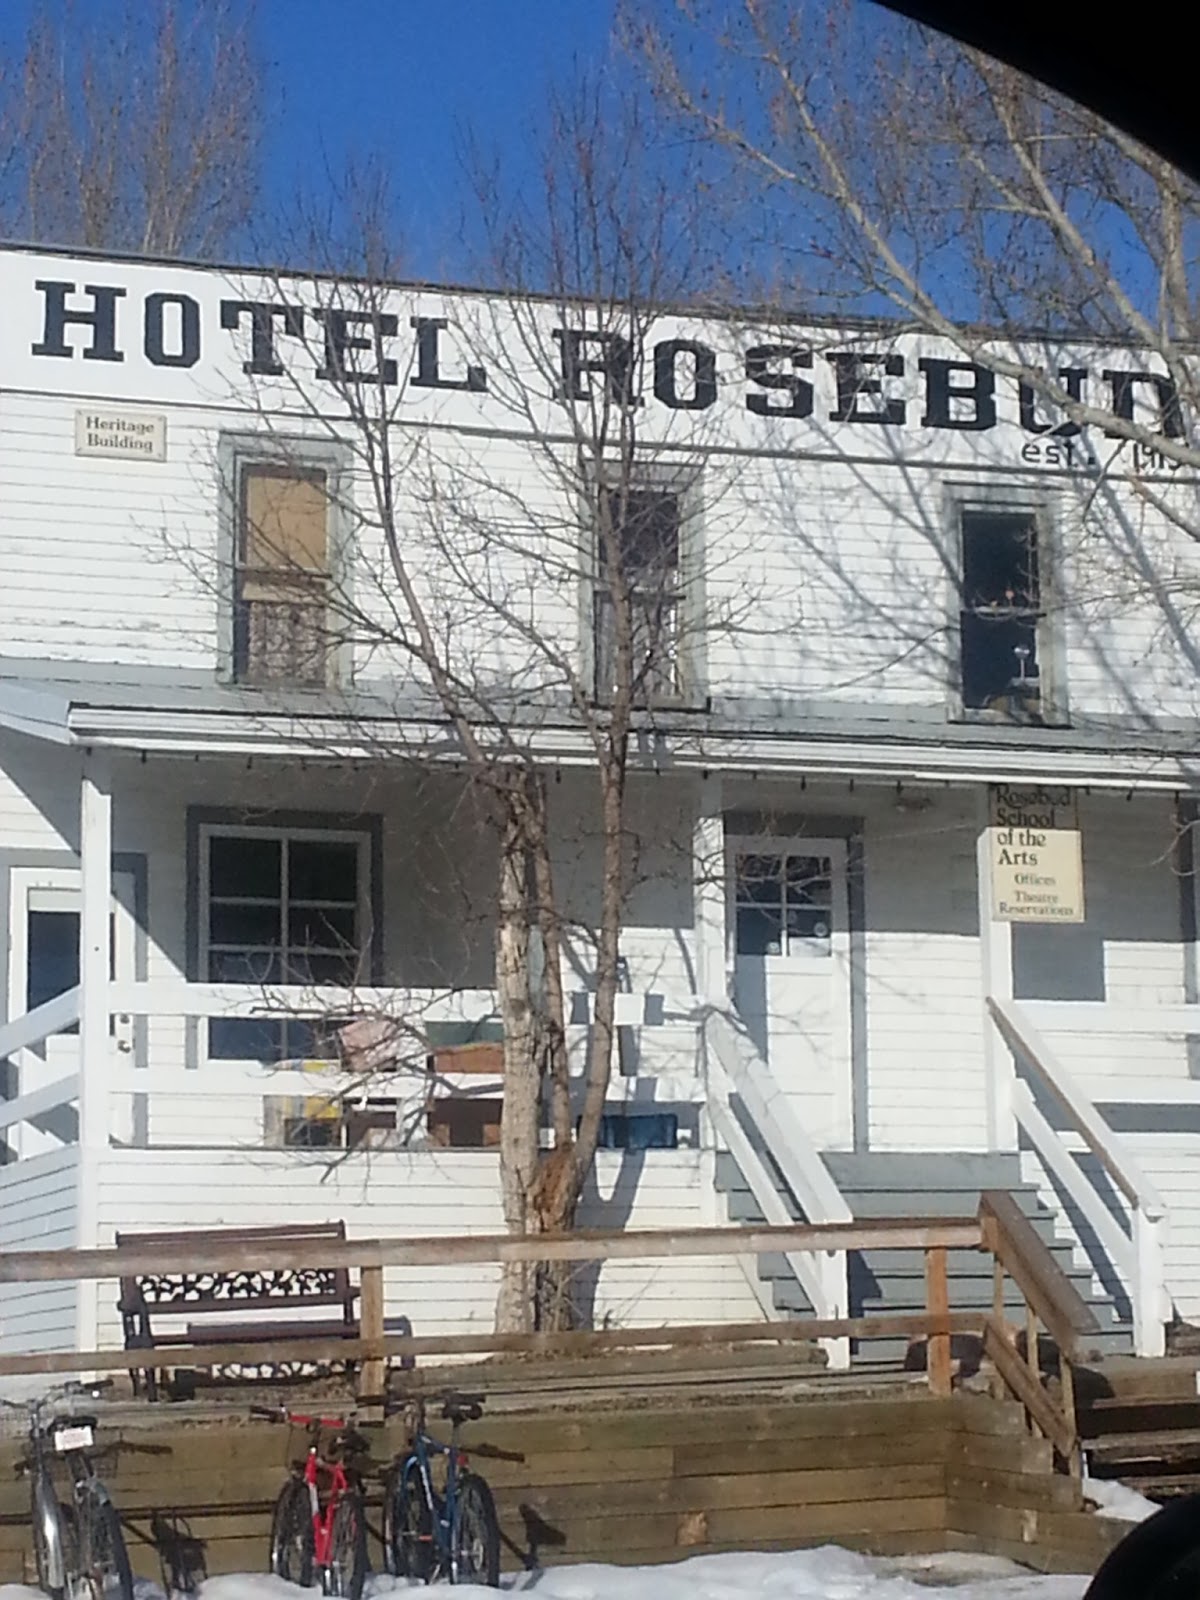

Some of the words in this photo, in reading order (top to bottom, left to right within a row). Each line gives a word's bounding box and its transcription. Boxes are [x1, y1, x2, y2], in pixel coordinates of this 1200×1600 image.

[32, 280, 487, 393] HOTEL
[552, 328, 1185, 440] ROSEBUD
[86, 416, 155, 435] Heritage
[88, 433, 153, 454] Building
[996, 783, 1071, 809] Rosebud
[996, 808, 1056, 827] School
[997, 828, 1014, 846] of
[1019, 829, 1046, 847] the
[998, 848, 1038, 866] Arts
[1014, 873, 1056, 886] Offices
[1014, 891, 1058, 904] Theatre
[999, 902, 1074, 916] Reservations
